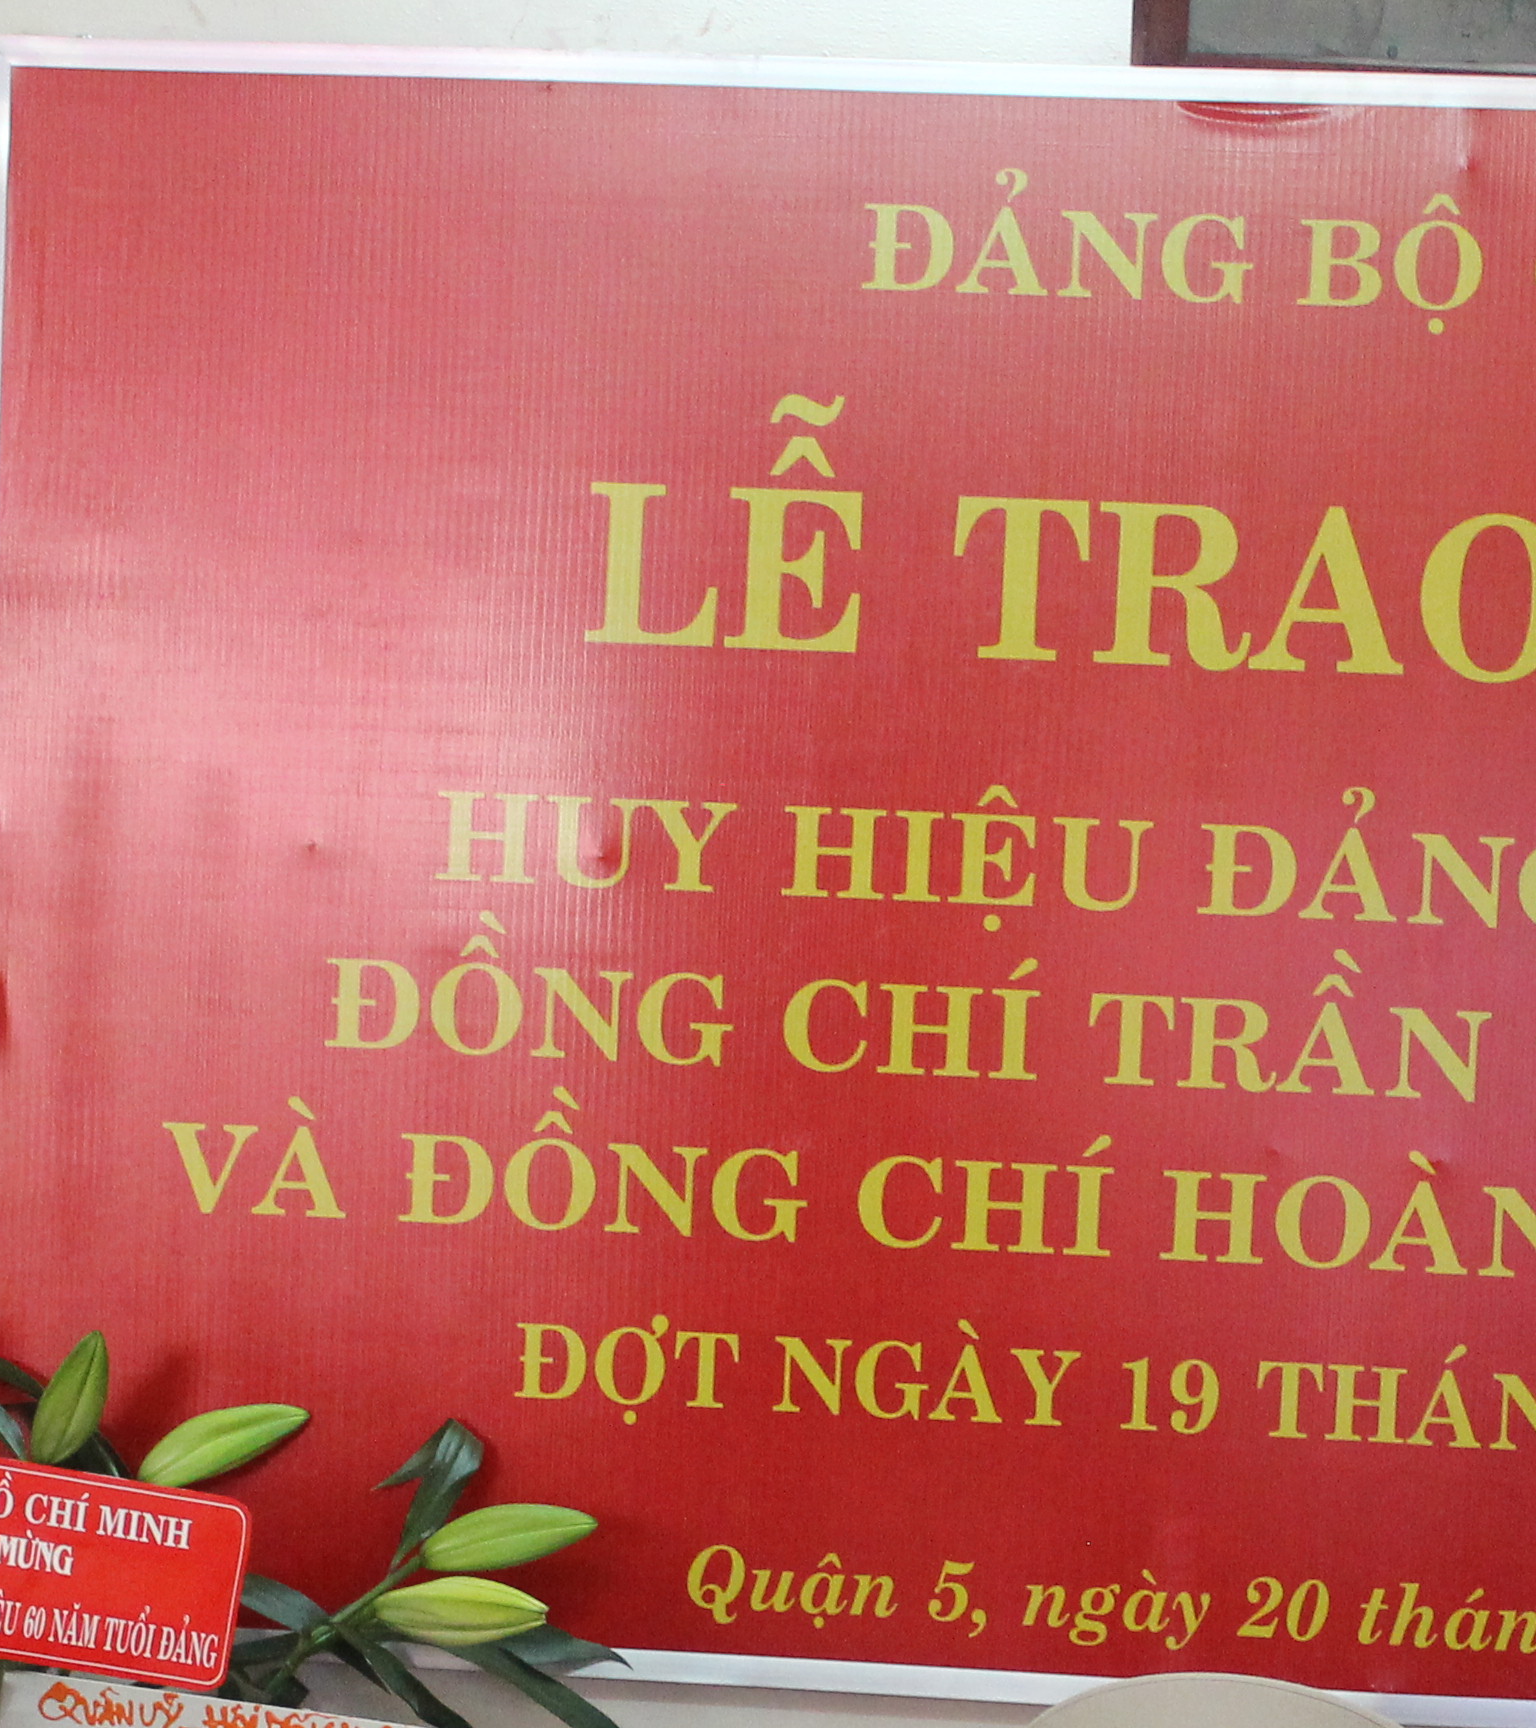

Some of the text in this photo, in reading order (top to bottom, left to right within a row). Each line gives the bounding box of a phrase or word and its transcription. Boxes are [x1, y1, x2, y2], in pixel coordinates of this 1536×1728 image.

[864, 171, 1252, 302] ĐẢNG
[1298, 195, 1483, 333] BỘ
[588, 394, 863, 652] LỄ
[434, 788, 738, 892] HUY
[781, 785, 1154, 931] HIỆU
[325, 910, 733, 1066] ĐỒNG
[784, 958, 1040, 1080] CHÍ
[1090, 949, 1491, 1101] TRẦN
[165, 1097, 345, 1218] VÀ
[400, 1087, 807, 1242] ĐỒNG
[858, 1135, 1114, 1256] CHÍ
[514, 1314, 739, 1426] ĐỢT
[773, 1319, 1081, 1425] NGÀY
[1121, 1358, 1219, 1434] 19
[25, 1493, 90, 1532] CHÍ
[97, 1505, 193, 1550] MINH
[23, 1606, 46, 1641] 60
[48, 1602, 99, 1650] NĂM
[104, 1605, 155, 1656] TUỔI
[158, 1614, 218, 1670] ĐẢNG
[686, 1544, 900, 1629] Quận
[929, 1561, 986, 1636] 5,
[1023, 1568, 1213, 1650] ngày
[1237, 1576, 1330, 1643] 20
